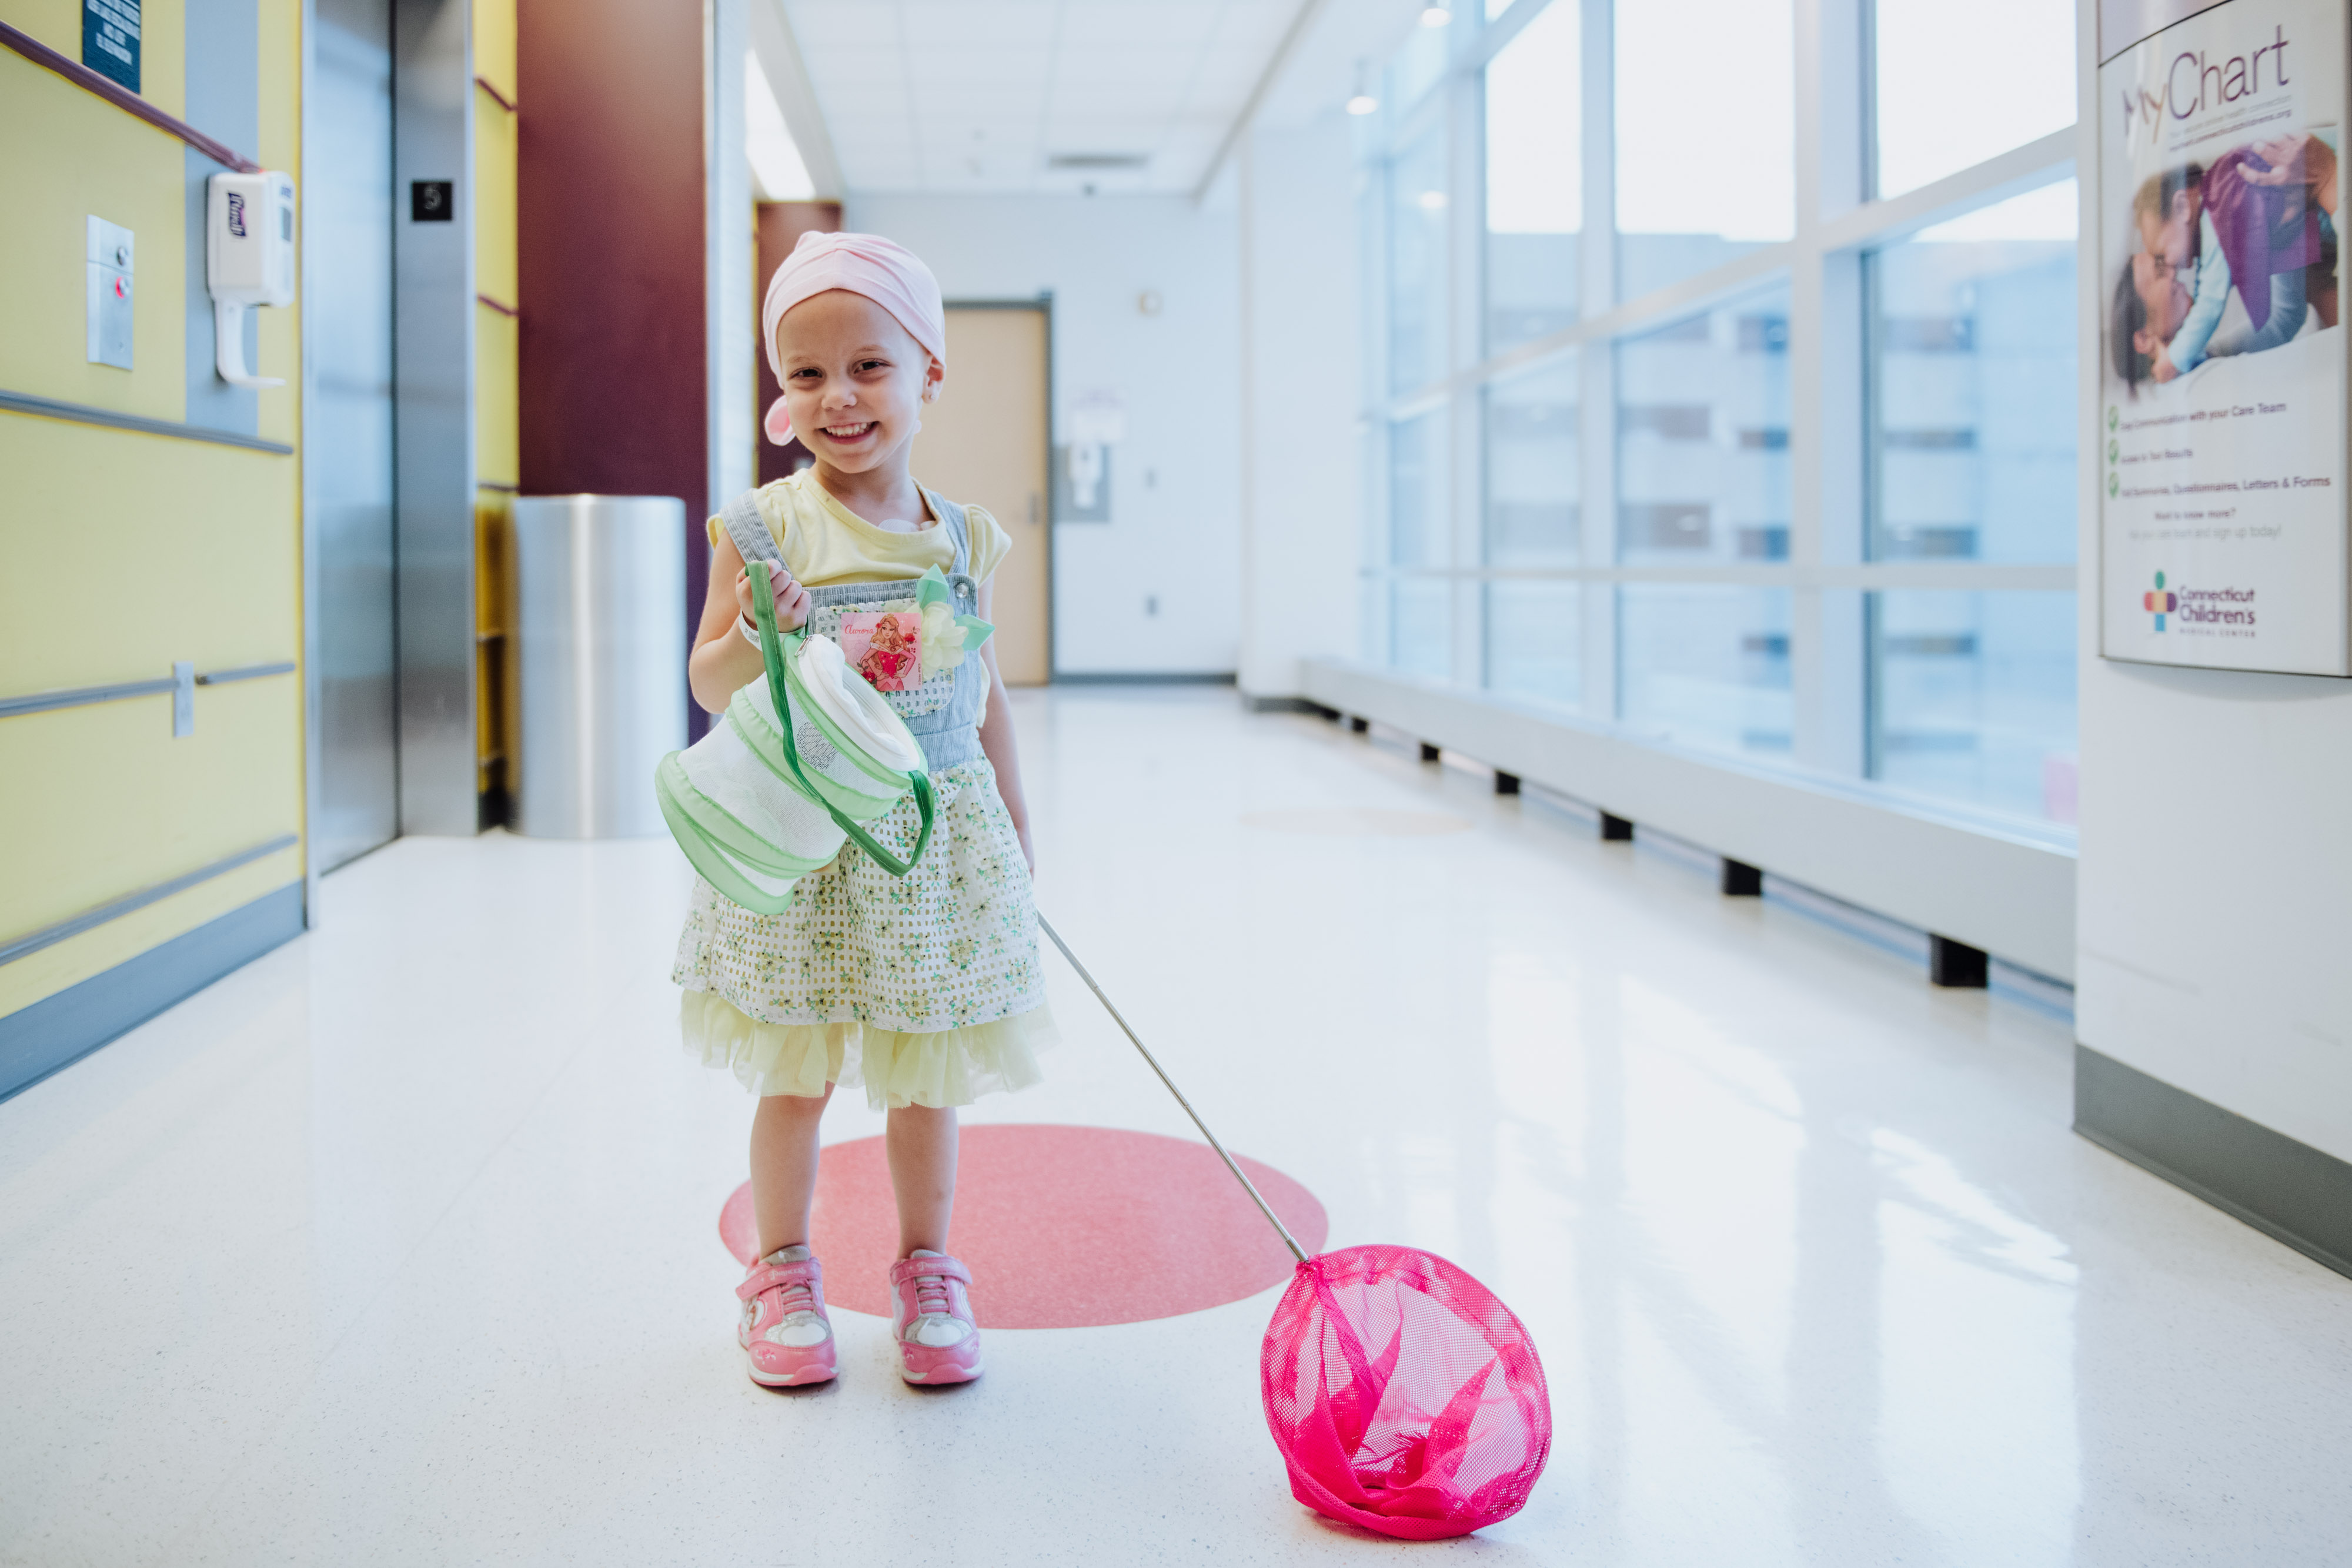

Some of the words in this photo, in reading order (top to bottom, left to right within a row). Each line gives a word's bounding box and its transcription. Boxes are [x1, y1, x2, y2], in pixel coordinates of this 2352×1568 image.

[2122, 24, 2290, 145] MyChart
[2189, 411, 2206, 421] with
[2209, 410, 2229, 423] your
[2232, 405, 2255, 416] Care
[2257, 402, 2287, 414] Team
[2243, 479, 2279, 491] Letters
[2282, 477, 2290, 489] &
[2293, 476, 2331, 488] Forms
[2207, 506, 2236, 518] more?
[2179, 585, 2255, 601] Connecticut
[2180, 604, 2256, 624] Children's
[844, 624, 874, 634] Aurora
